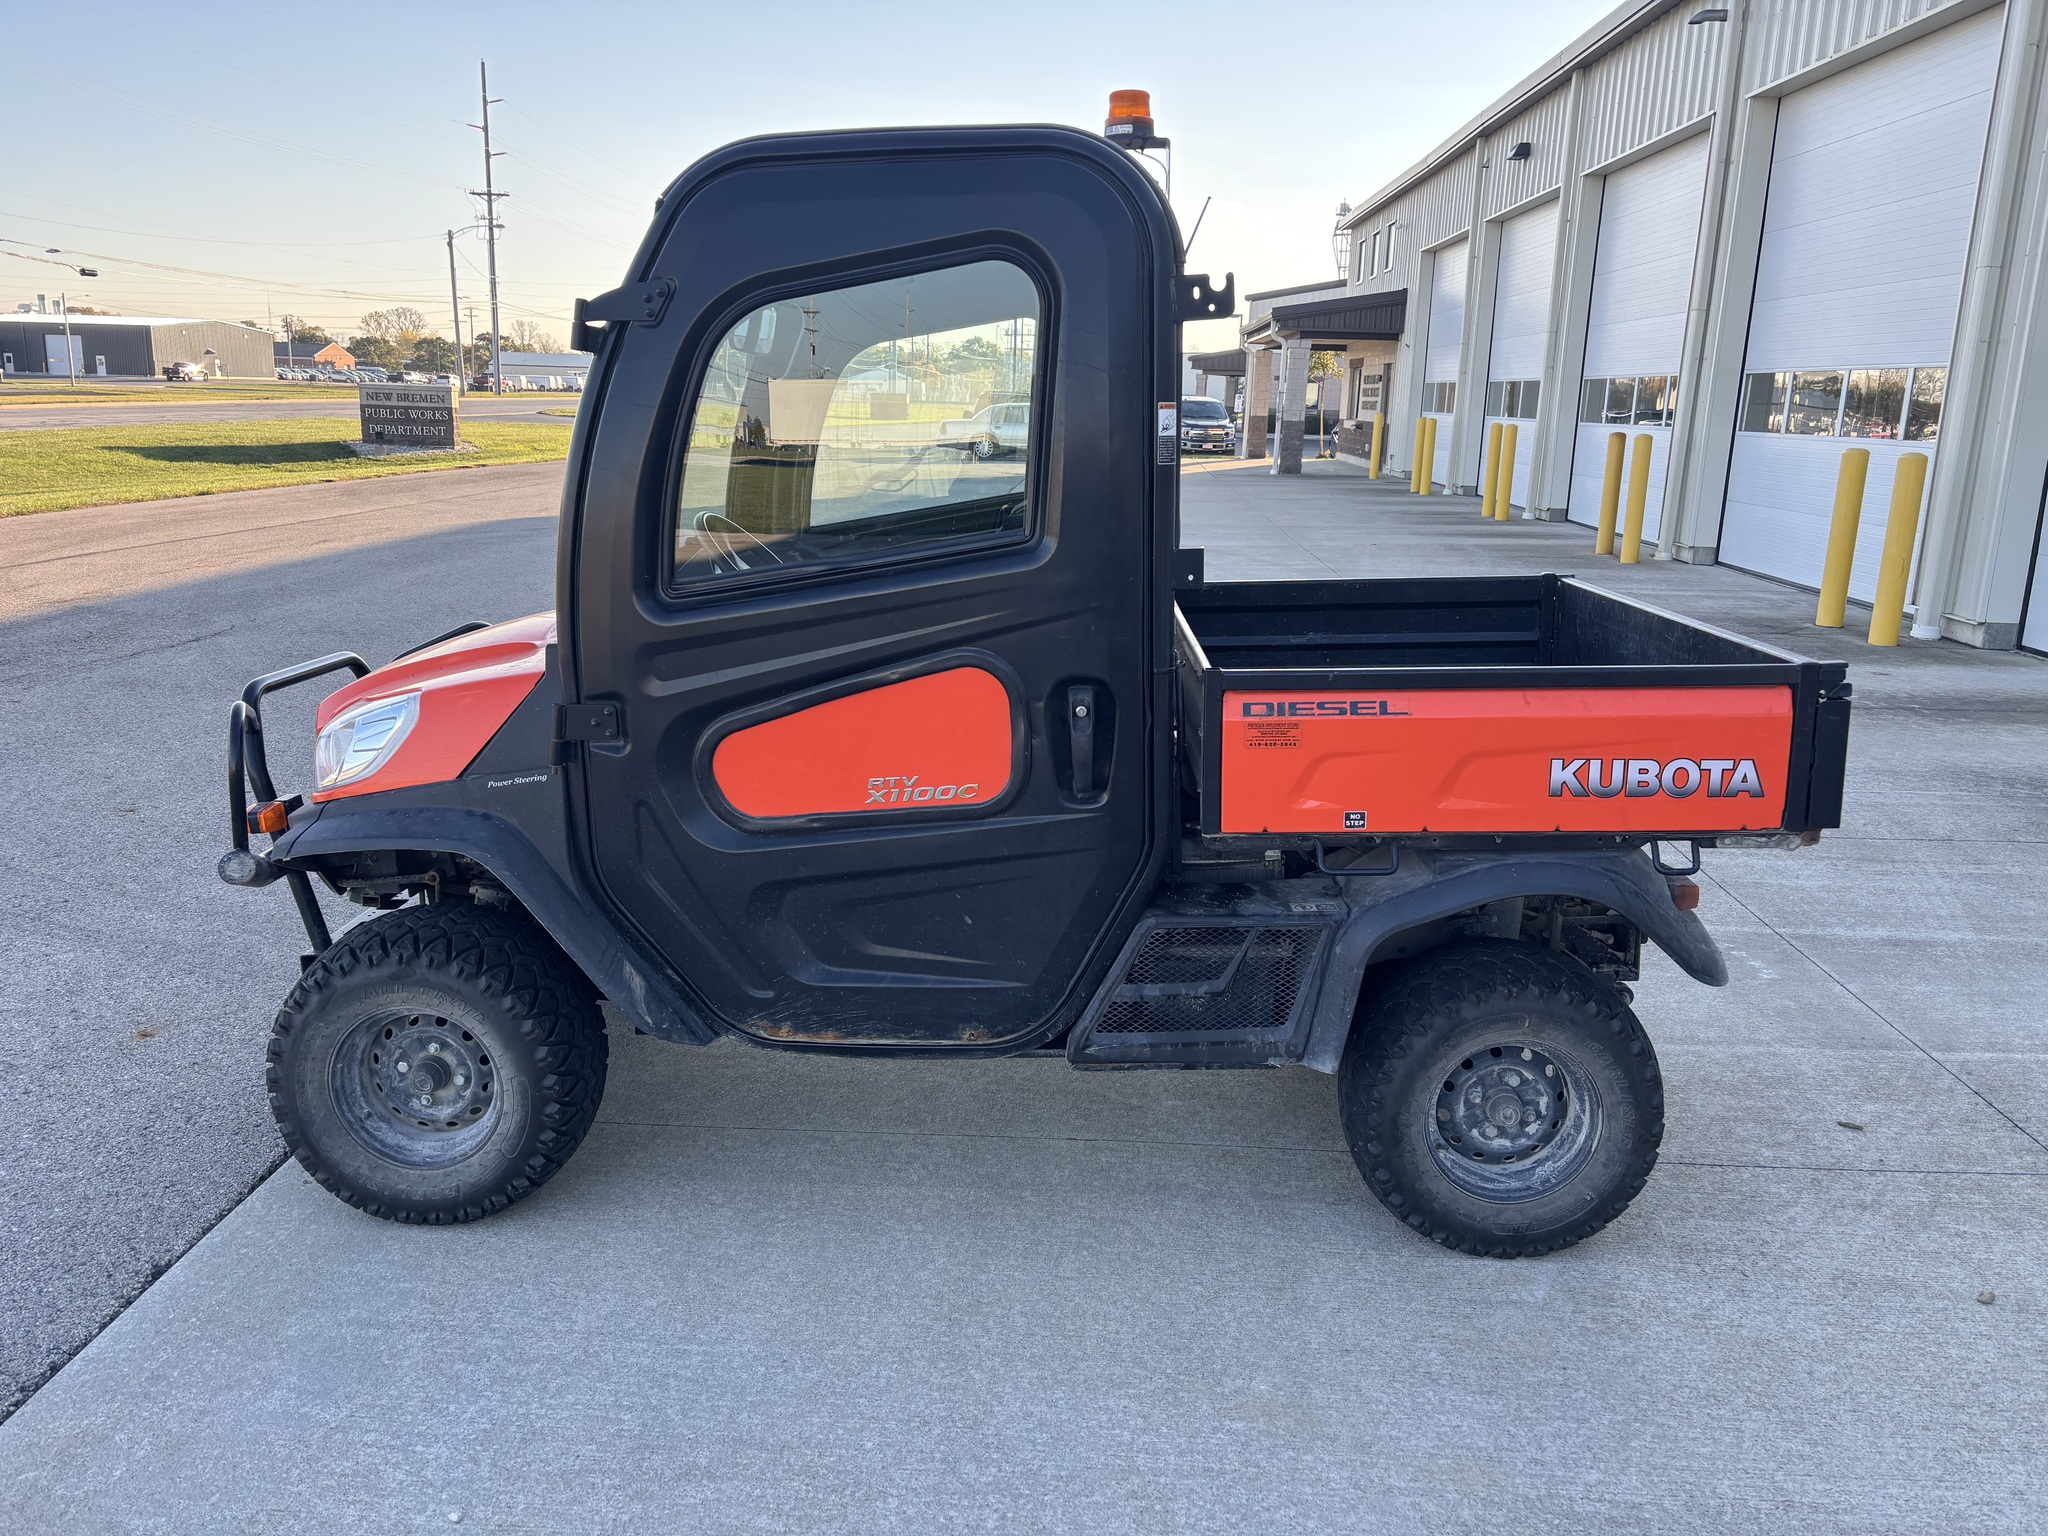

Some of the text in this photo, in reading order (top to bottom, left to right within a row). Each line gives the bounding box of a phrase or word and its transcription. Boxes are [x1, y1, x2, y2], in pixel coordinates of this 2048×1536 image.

[365, 391, 445, 404] NEW BREMEN
[364, 407, 449, 420] PUBLIC WORKS
[369, 424, 446, 436] DEPARTMENT
[1242, 700, 1409, 718] DIESEL
[487, 774, 548, 788] Power Steering
[867, 775, 919, 788] RTV
[1548, 757, 1765, 799] KUBOTA
[864, 783, 979, 804] X1100C
[362, 984, 486, 1026] ALL TRAIL
[1584, 1039, 1636, 1150] CARLISLE
